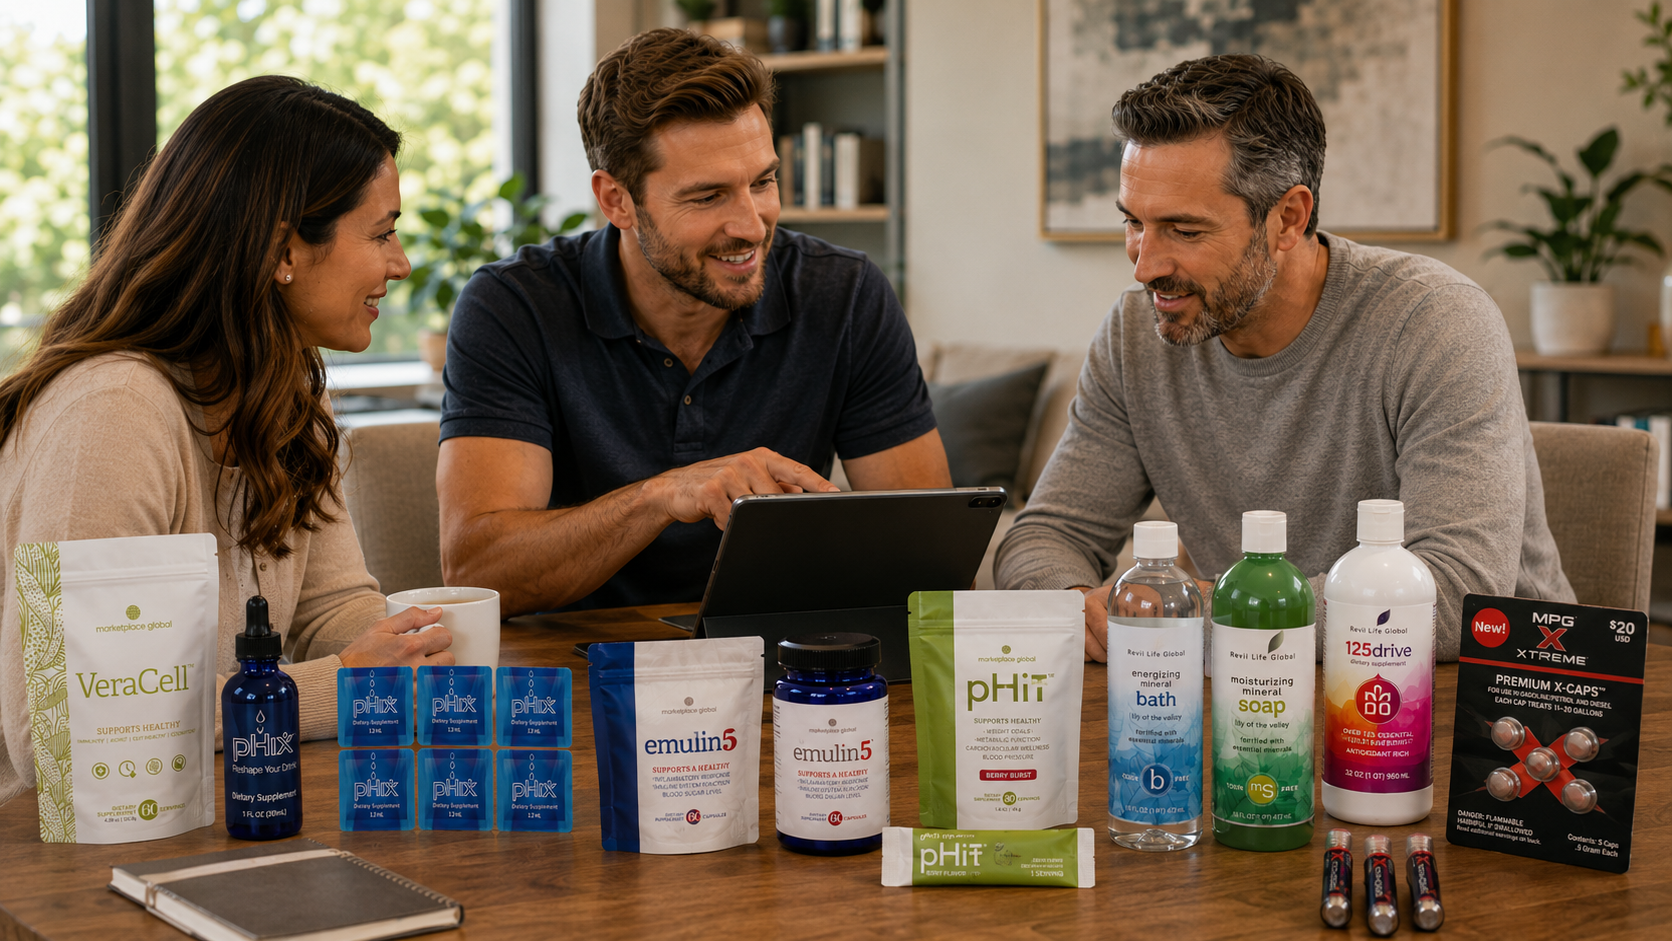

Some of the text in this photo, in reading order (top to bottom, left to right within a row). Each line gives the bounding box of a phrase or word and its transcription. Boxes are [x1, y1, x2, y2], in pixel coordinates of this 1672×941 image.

[96, 620, 173, 633] marketplace global
[1532, 612, 1575, 627] MPG
[1474, 621, 1506, 635] New!
[1609, 620, 1635, 635] $20
[1615, 635, 1631, 643] USD
[1345, 640, 1412, 658] 125drive
[1270, 653, 1296, 661] Global
[1516, 648, 1586, 666] XTREME
[1131, 670, 1181, 680] energizing
[1230, 676, 1294, 687] moisturizing
[1495, 673, 1551, 692] PREMIUM
[1140, 680, 1172, 688] mineral
[1242, 687, 1282, 696] mineral
[1136, 690, 1177, 707] bath
[1238, 699, 1286, 718] soap
[96, 720, 181, 735] SUPPORTS HEALTHY
[974, 717, 1042, 725] SUPPORTS HEALTHY
[644, 728, 738, 755] emulin5
[793, 739, 873, 762] emulin5
[264, 765, 281, 773] Your
[652, 765, 691, 774] SUPPORTS
[1150, 768, 1165, 790] b
[141, 802, 158, 817] 60
